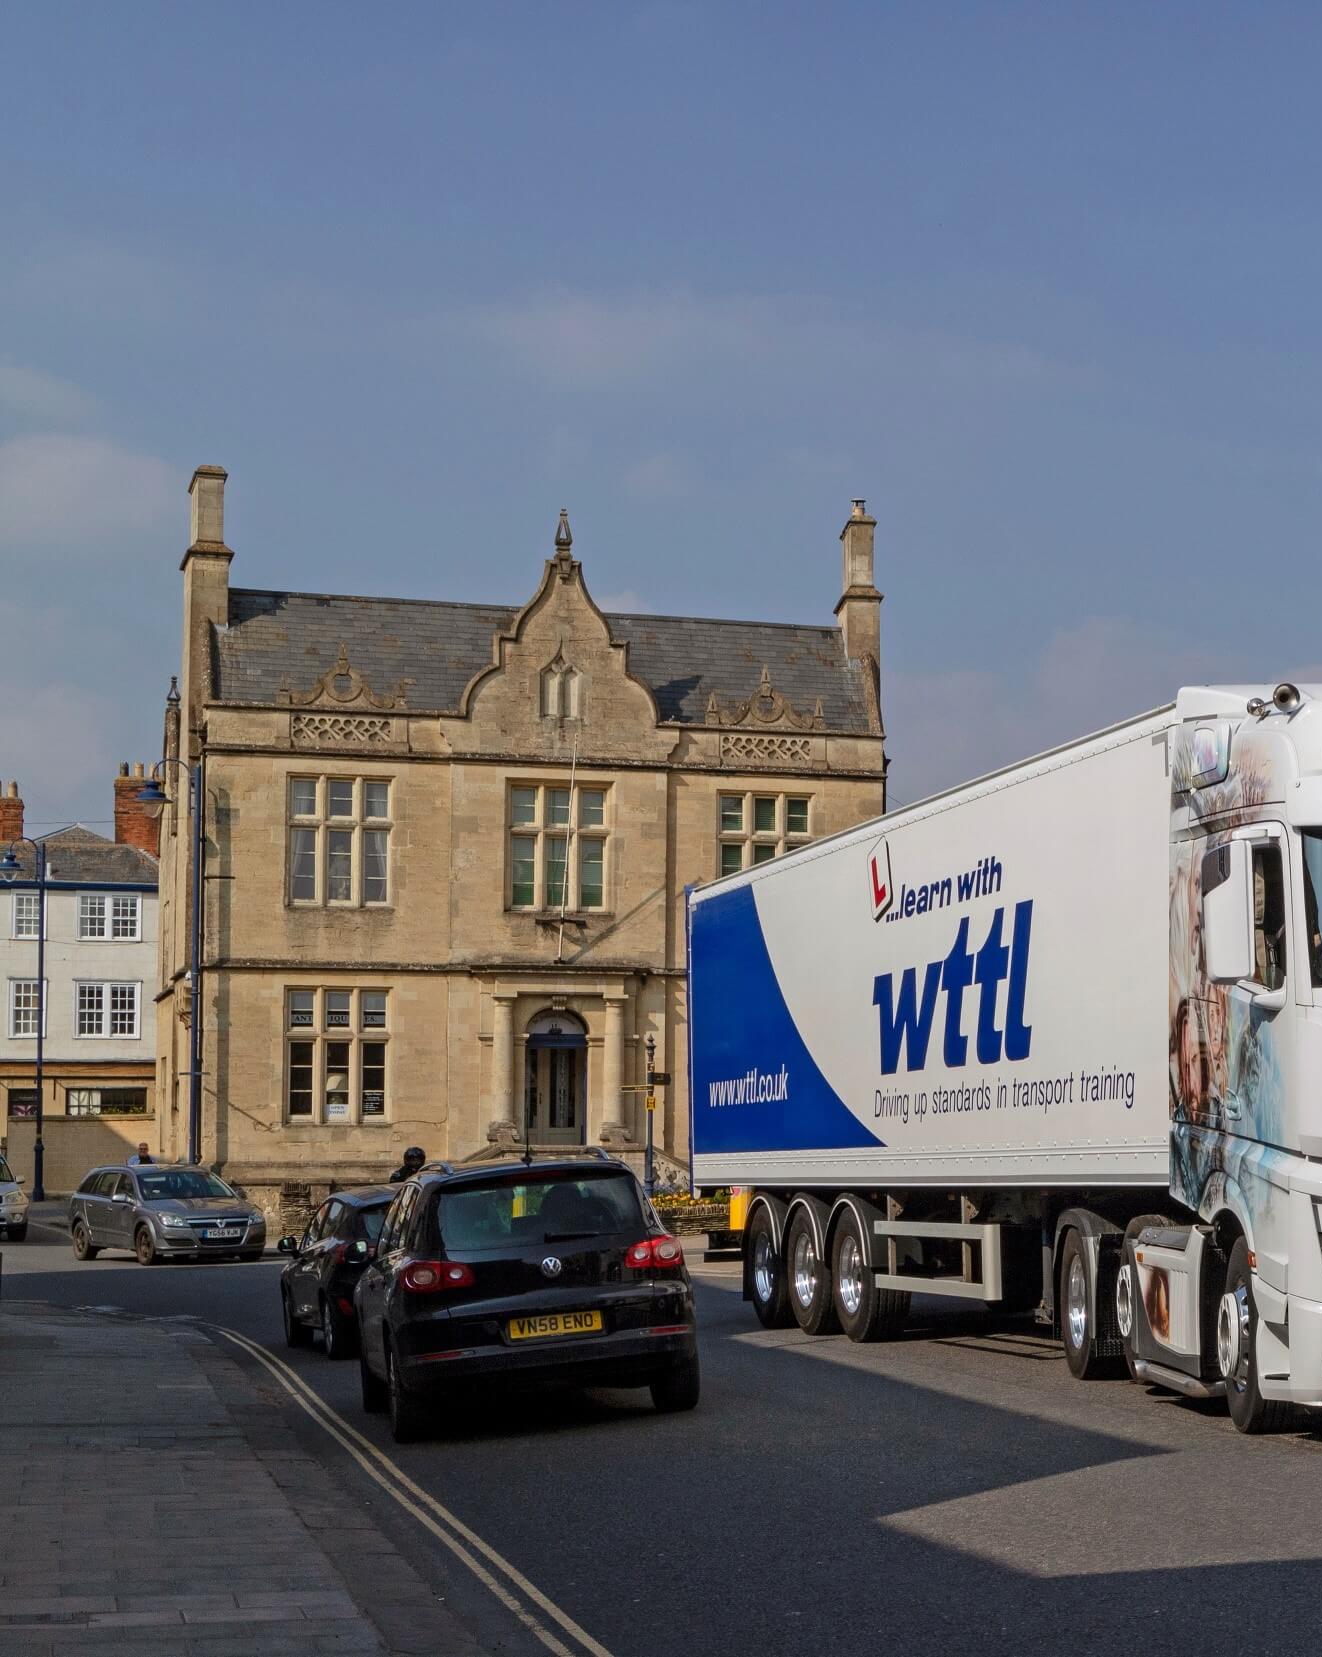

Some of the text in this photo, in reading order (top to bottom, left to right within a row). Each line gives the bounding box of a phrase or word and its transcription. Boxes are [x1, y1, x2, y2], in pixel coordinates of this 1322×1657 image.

[871, 856, 887, 909] L
[957, 856, 1002, 902] with
[872, 899, 1034, 1076] wttl
[709, 1063, 789, 1108] www.wttl.co.uk
[874, 1065, 1136, 1124] Driving up standards in transport training
[516, 1314, 594, 1334] VN58 ENO
